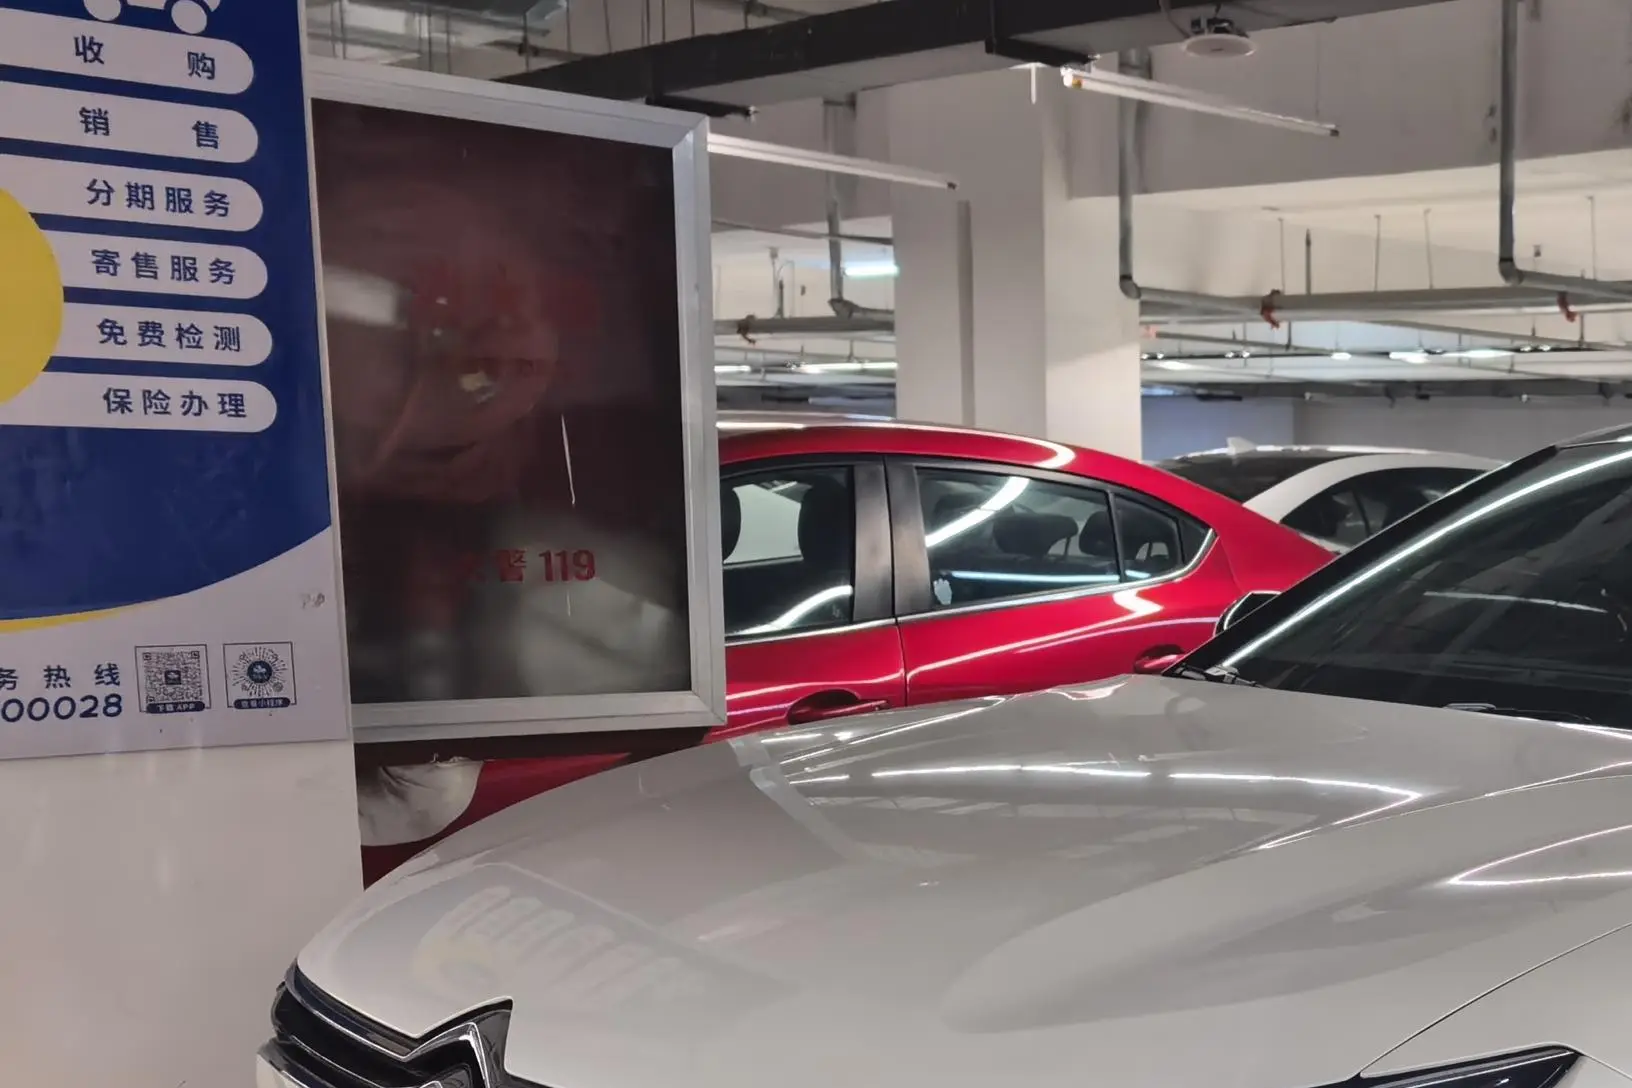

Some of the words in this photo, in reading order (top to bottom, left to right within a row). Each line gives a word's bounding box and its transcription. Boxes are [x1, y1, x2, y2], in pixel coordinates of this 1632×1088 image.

[74, 35, 216, 80] 收购
[79, 107, 220, 149] 销售
[86, 178, 230, 217] 分期服务
[91, 249, 235, 285] 寄售服务
[97, 318, 241, 352] 免费检测
[103, 388, 246, 418] 保险办理
[538, 549, 596, 582] 119
[1, 693, 123, 722] 00028
